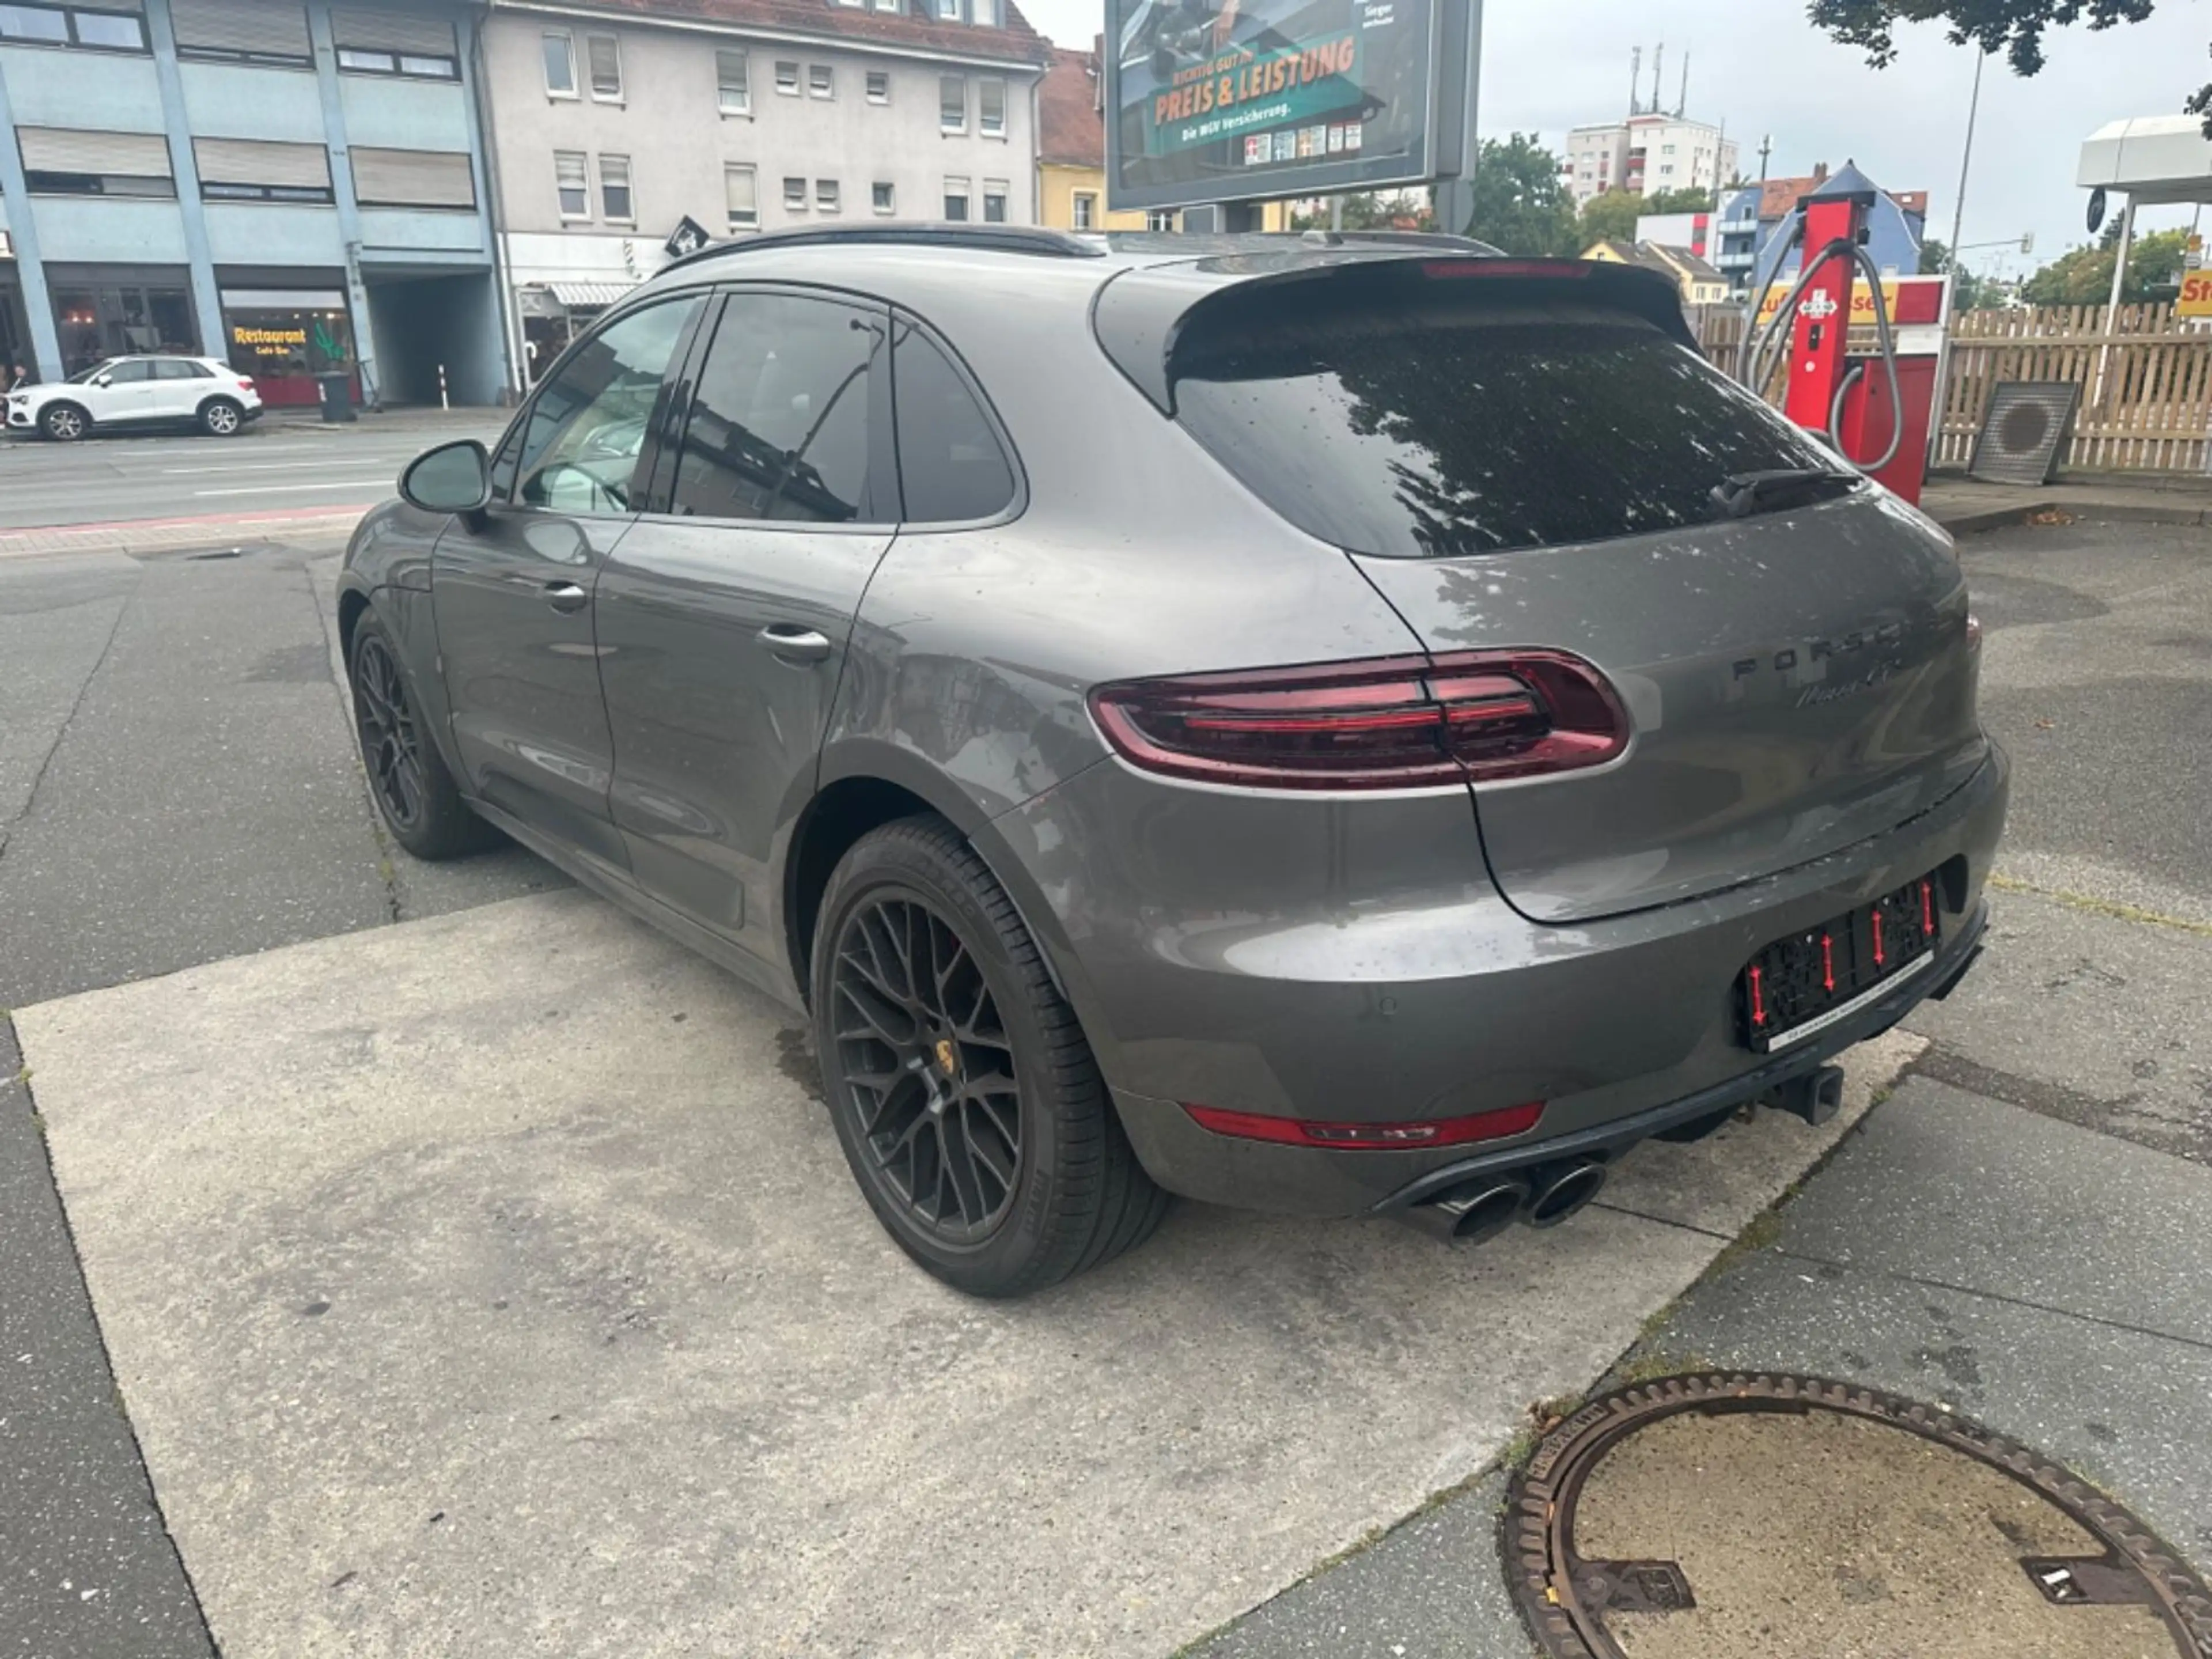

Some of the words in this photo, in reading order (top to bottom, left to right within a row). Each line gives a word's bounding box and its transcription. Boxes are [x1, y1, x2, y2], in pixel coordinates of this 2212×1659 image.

[1155, 78, 1214, 126] PREIS
[1217, 75, 1234, 107] &
[1238, 35, 1354, 102] LEISTUNG
[2181, 279, 2212, 302] St
[234, 326, 306, 344] Restaurant
